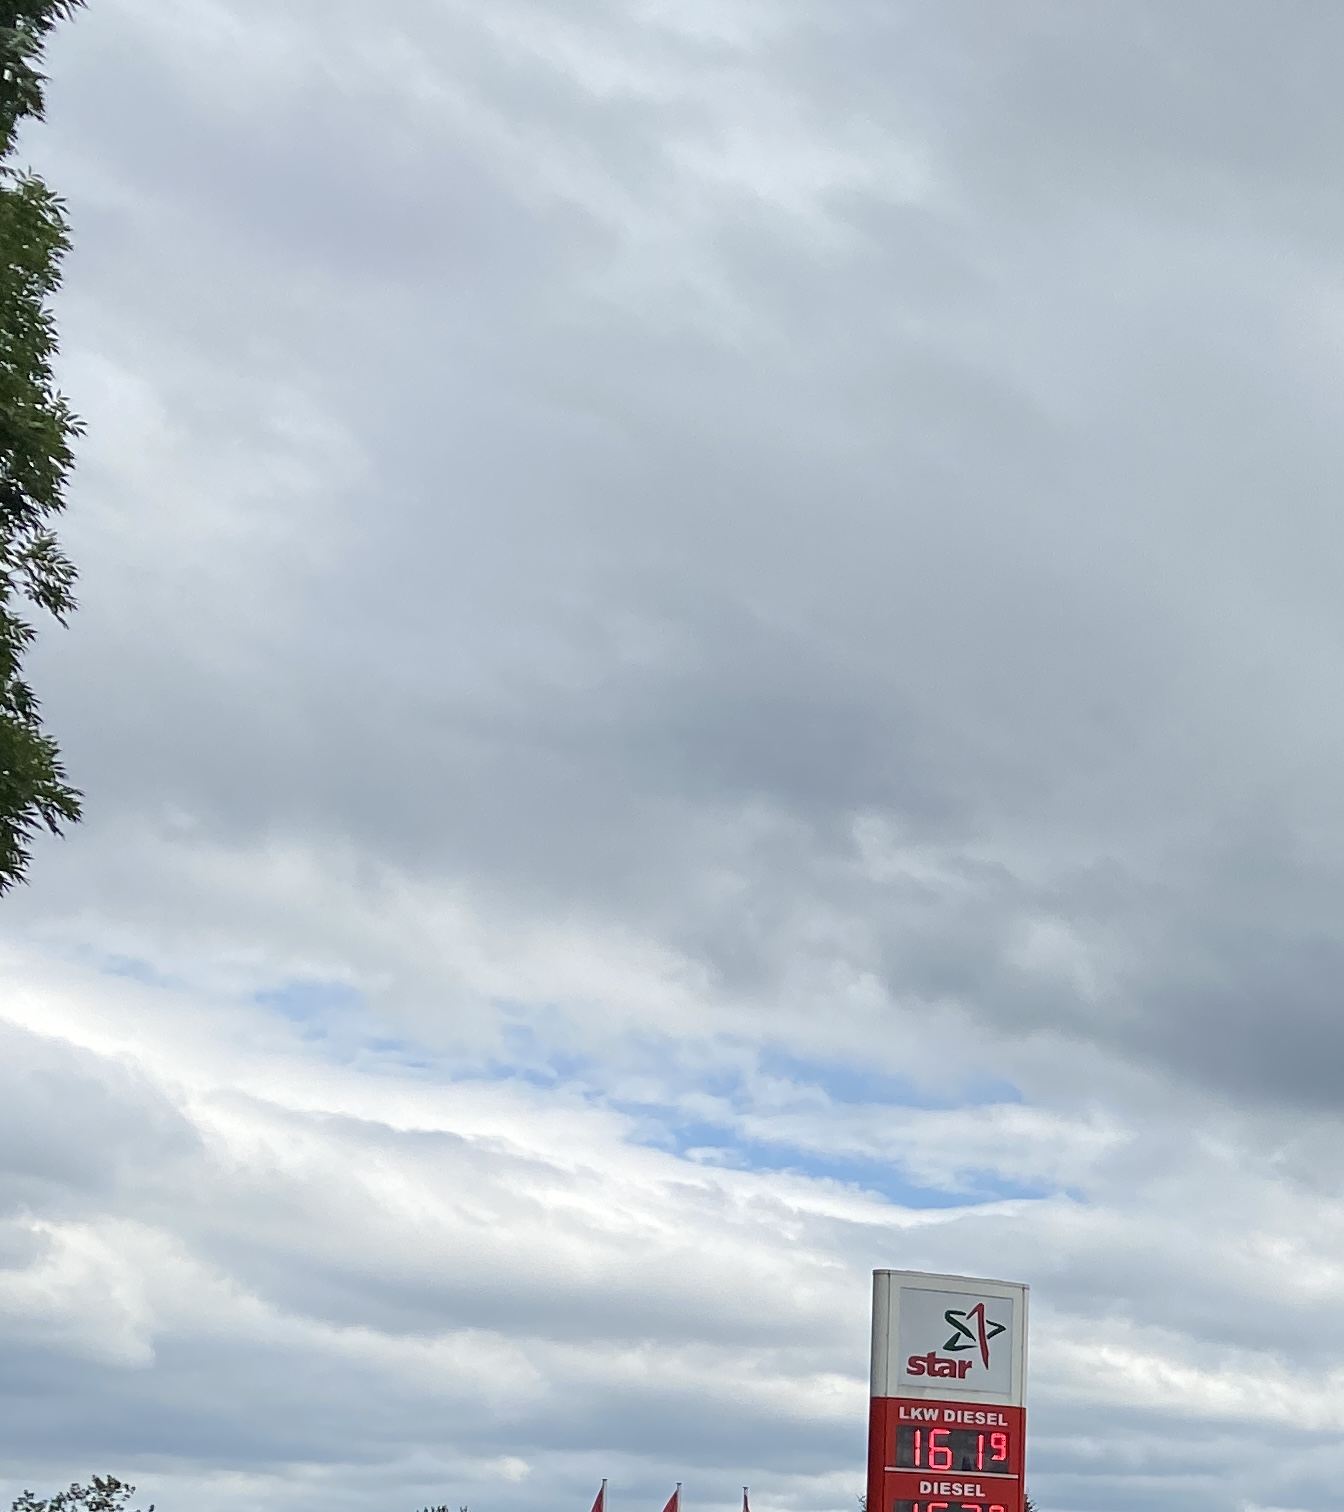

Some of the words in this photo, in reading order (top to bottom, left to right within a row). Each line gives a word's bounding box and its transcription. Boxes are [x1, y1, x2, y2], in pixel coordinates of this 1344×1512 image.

[906, 1351, 973, 1379] star
[899, 1406, 939, 1421] LKW
[944, 1410, 1008, 1427] DIESEL
[919, 1480, 986, 1497] DIESEL
